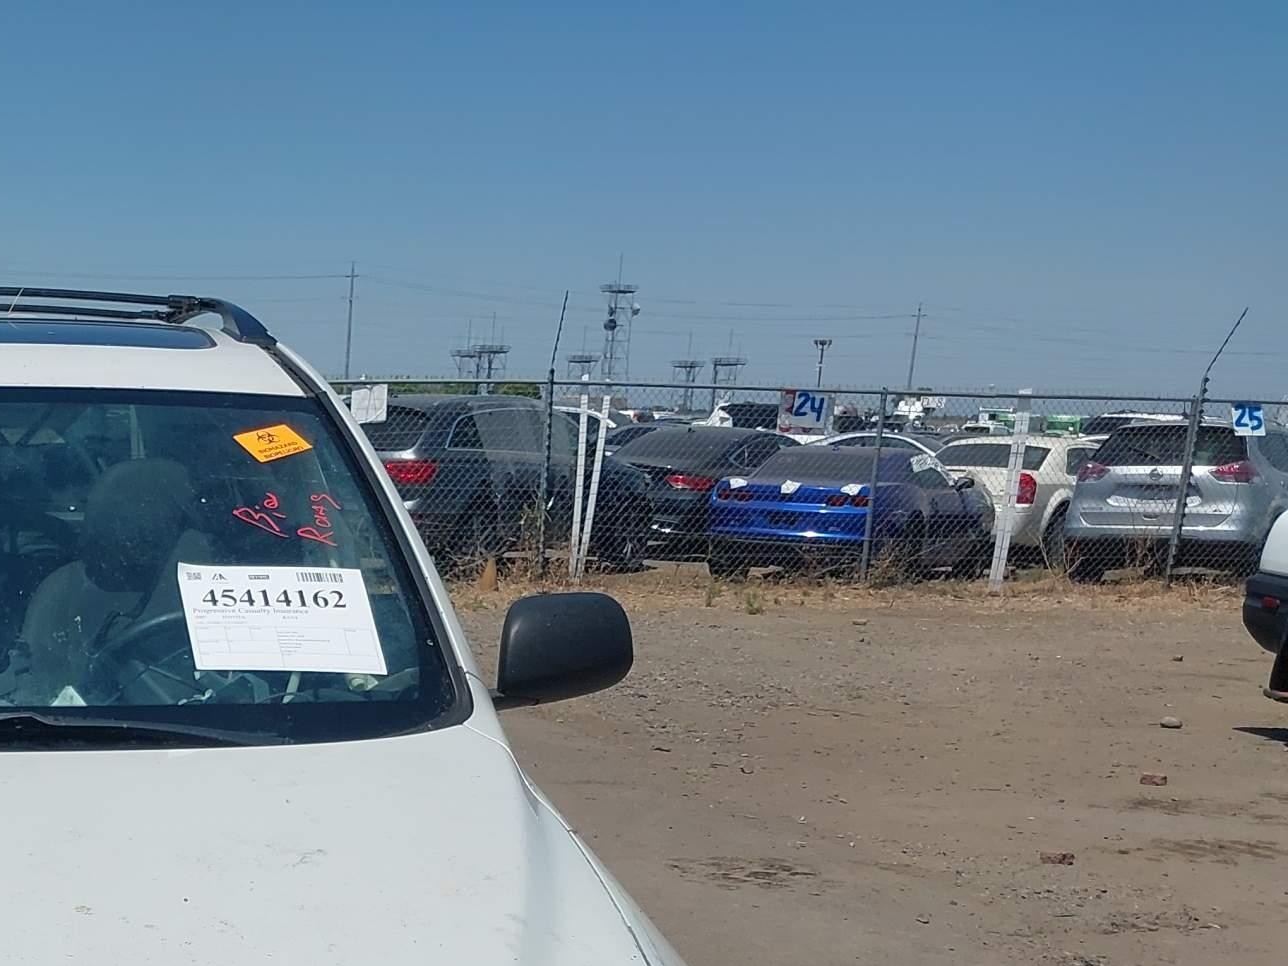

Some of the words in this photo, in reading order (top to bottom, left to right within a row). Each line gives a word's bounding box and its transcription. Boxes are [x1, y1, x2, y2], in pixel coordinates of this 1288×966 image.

[793, 392, 825, 422] 24
[1234, 403, 1263, 430] 25
[202, 589, 347, 608] 45414162
